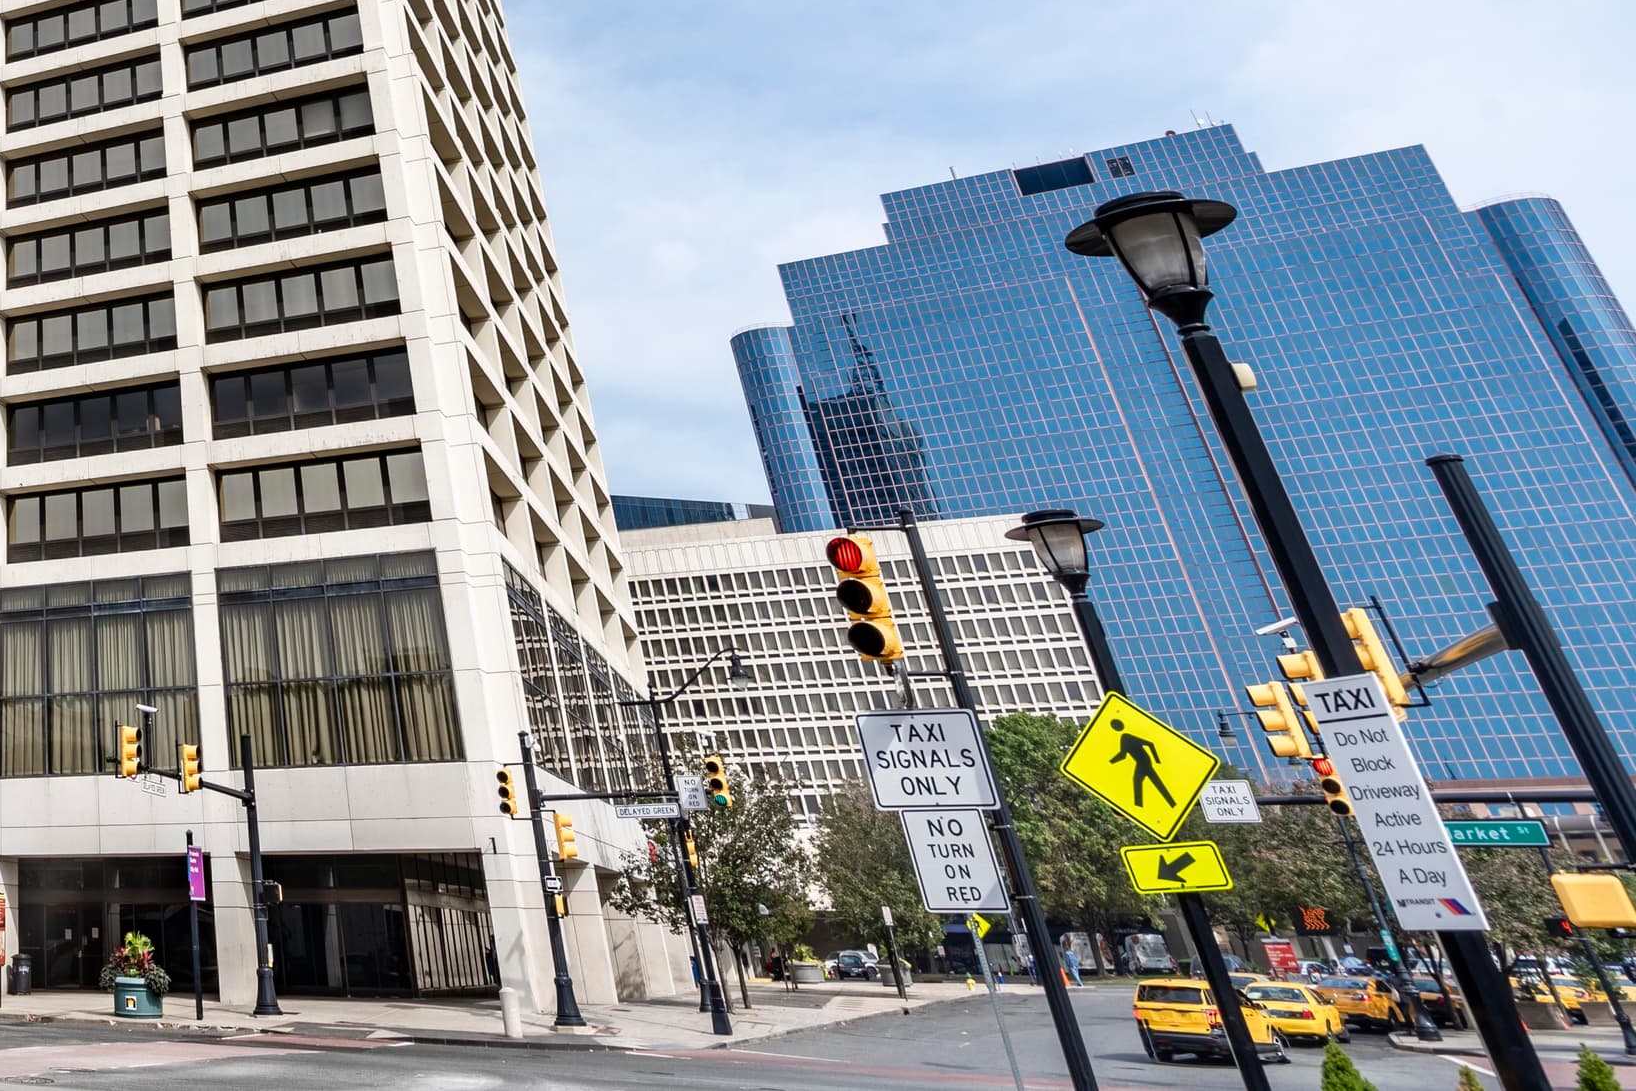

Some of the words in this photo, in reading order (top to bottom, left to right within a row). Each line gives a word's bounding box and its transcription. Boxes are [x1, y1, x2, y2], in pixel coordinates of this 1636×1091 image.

[1314, 687, 1376, 713] TAXI
[890, 723, 945, 742] TAXI
[1334, 732, 1358, 747] Do
[1359, 728, 1389, 744] Not
[876, 748, 976, 769] SIGNALS
[1351, 756, 1396, 773] Block
[901, 776, 960, 796] ONLY
[1350, 784, 1420, 800] Driveway
[1205, 796, 1250, 805] SIGNALS
[619, 807, 651, 816] DELAYED
[1217, 807, 1244, 816] ONLY
[1375, 811, 1422, 827] Active
[927, 818, 963, 837] NO
[927, 843, 975, 858] TURN
[1373, 841, 1394, 856] 24
[1396, 839, 1448, 854] Hours
[944, 864, 971, 879] ON
[1399, 869, 1412, 884] A
[1413, 868, 1447, 887] Day
[946, 886, 981, 901] RED
